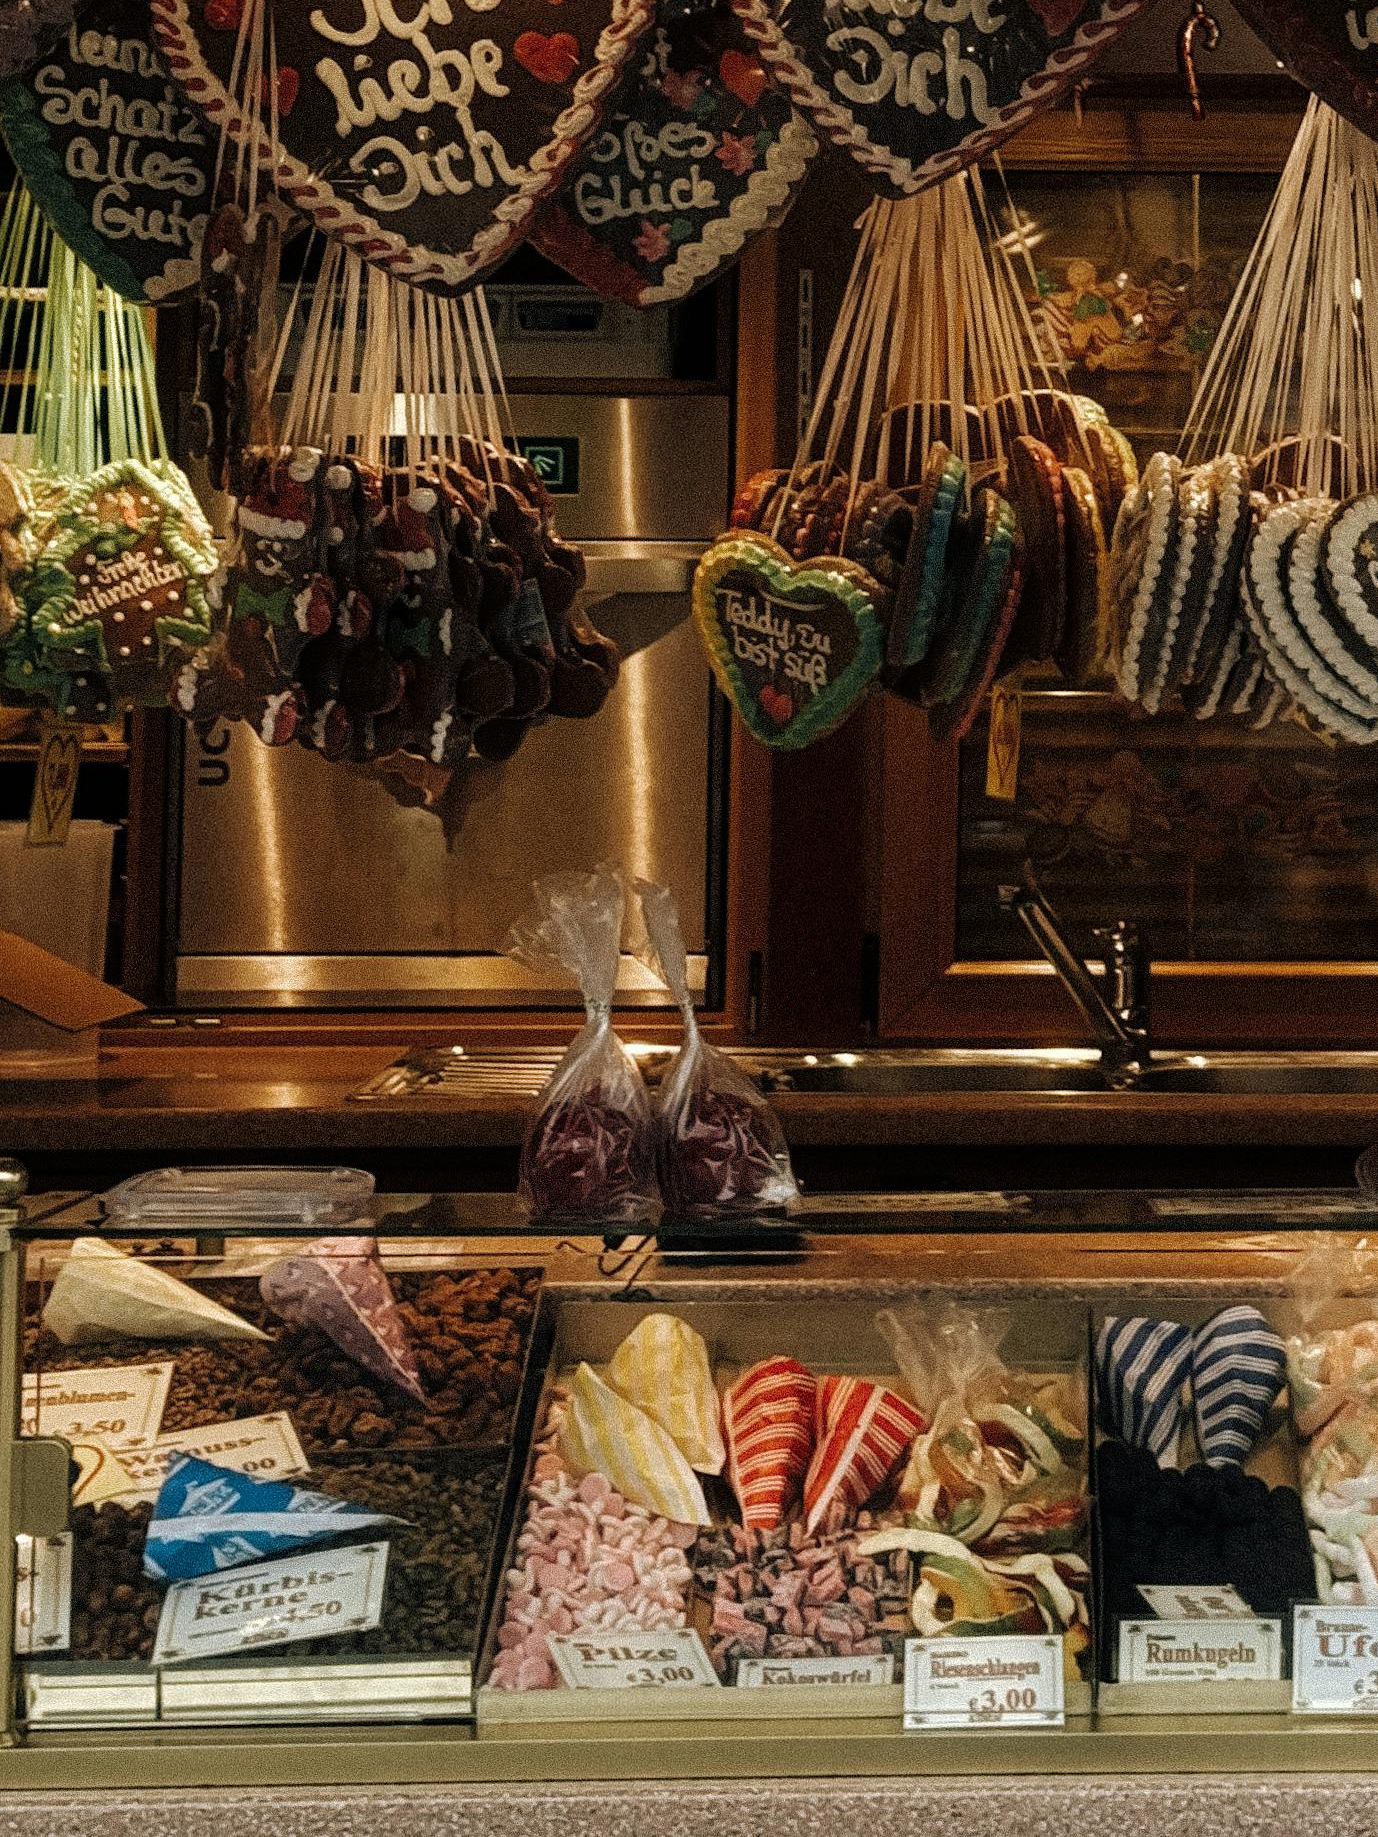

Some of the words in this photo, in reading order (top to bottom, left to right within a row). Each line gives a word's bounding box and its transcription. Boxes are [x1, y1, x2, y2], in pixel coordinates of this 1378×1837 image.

[34, 64, 207, 144] Schatz
[315, 32, 511, 137] liebe
[825, 24, 1003, 125] Dich
[65, 135, 207, 197] alles
[349, 107, 532, 211] Dich
[194, 1591, 308, 1620] kerne
[578, 1646, 679, 1663] Pilze
[1146, 1642, 1257, 1669] Rumkugeln
